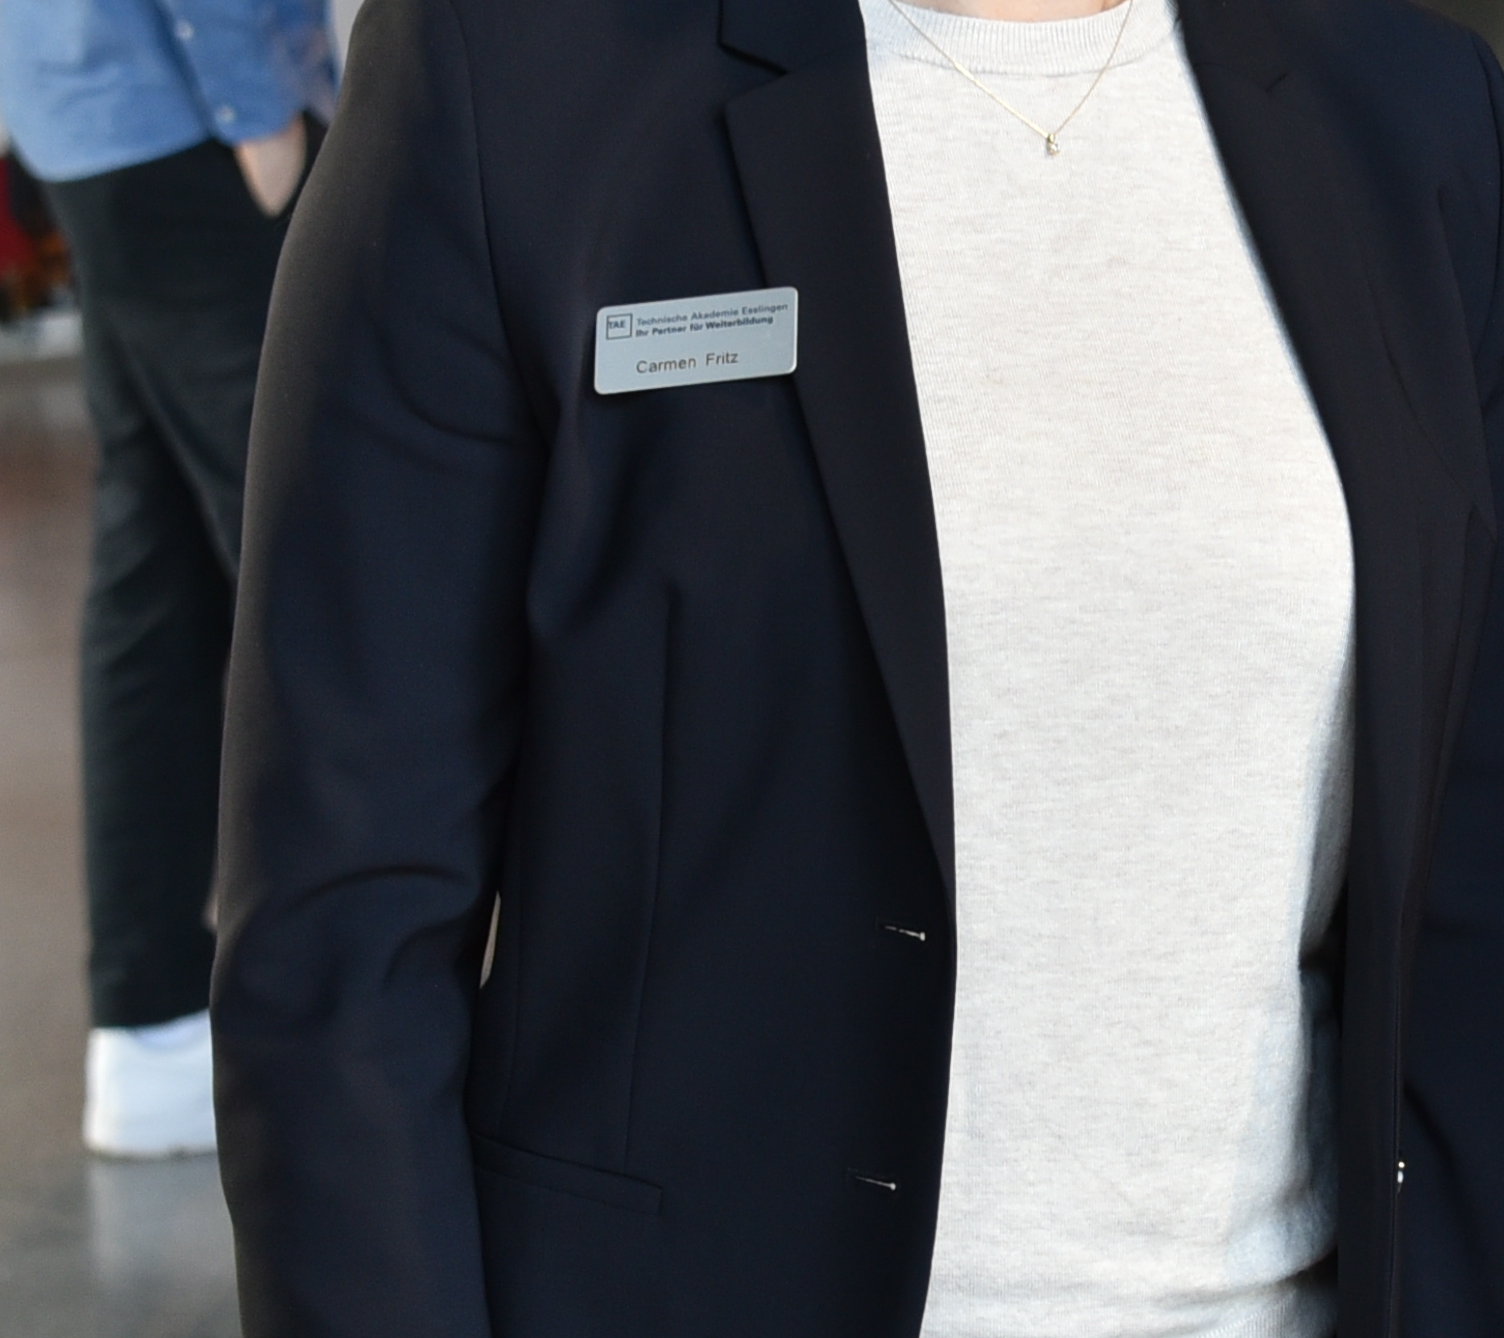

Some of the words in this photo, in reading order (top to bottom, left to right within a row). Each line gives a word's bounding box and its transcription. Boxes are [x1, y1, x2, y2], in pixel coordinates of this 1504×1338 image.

[635, 328, 650, 338] Ihr
[651, 323, 687, 336] Partner
[689, 321, 705, 332] für
[705, 314, 774, 330] Weiterbildung
[636, 313, 688, 327] Technische
[690, 306, 739, 321] Akademie
[741, 302, 789, 317] Esslingen
[636, 356, 697, 374] Carmen
[705, 350, 739, 366] Fritz
